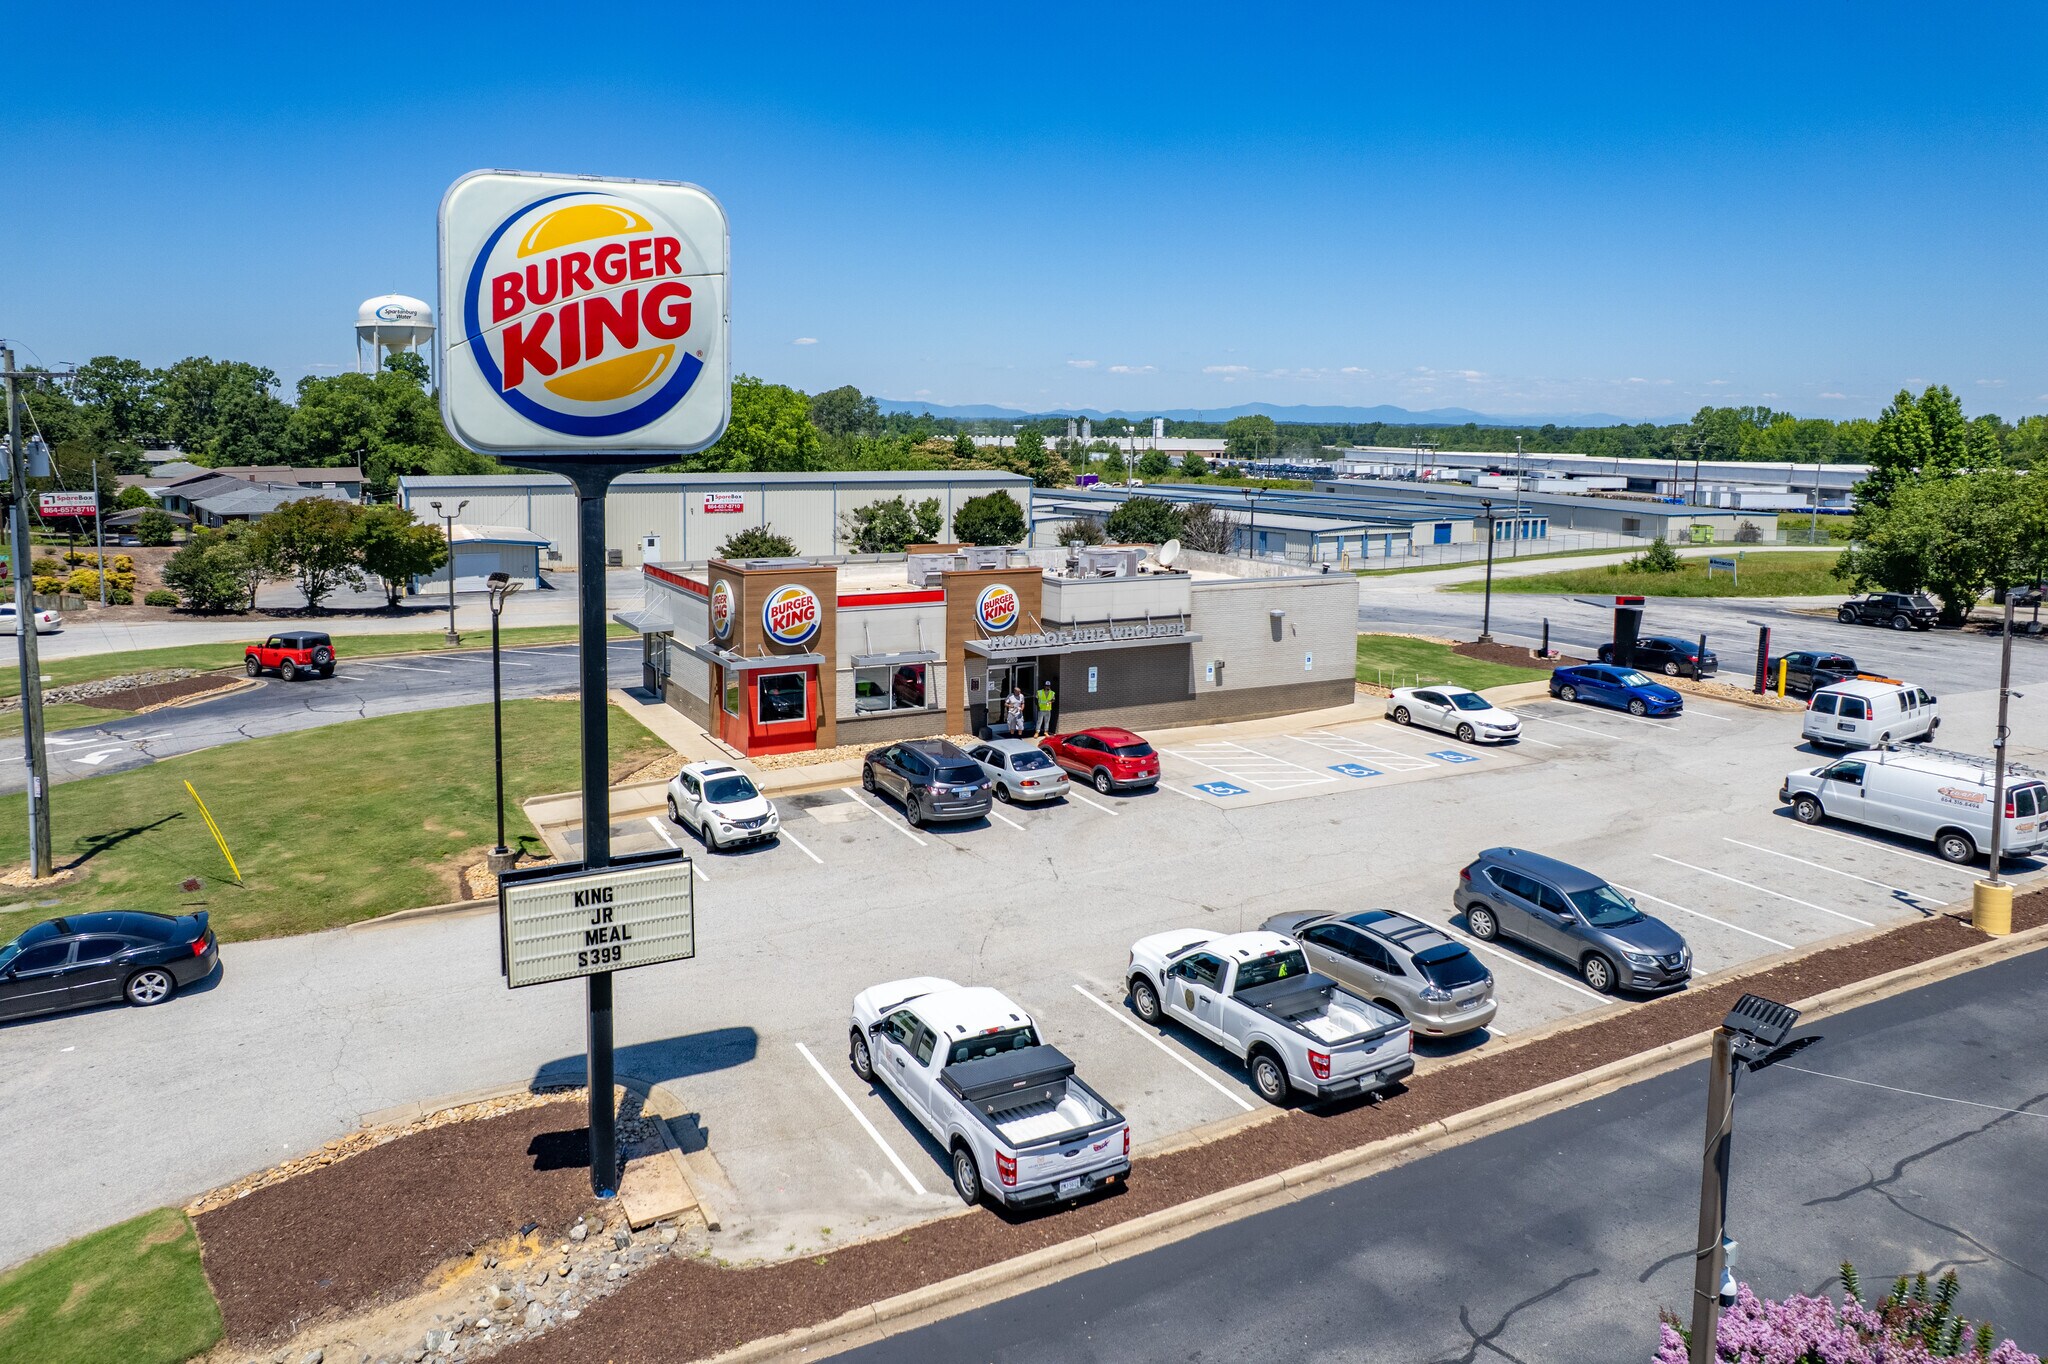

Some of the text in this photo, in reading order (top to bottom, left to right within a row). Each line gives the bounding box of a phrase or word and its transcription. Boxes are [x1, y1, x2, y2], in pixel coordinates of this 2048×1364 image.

[492, 236, 682, 324] BURGER
[502, 281, 692, 391] KING
[771, 595, 813, 618] BURGER
[984, 593, 1014, 611] BURGER
[984, 600, 1015, 622] KING
[772, 606, 815, 633] KING
[991, 623, 1186, 649] HOME OF THE WHOPPER
[575, 887, 613, 907] KING
[591, 906, 613, 925] JR
[586, 924, 632, 946] MEAL
